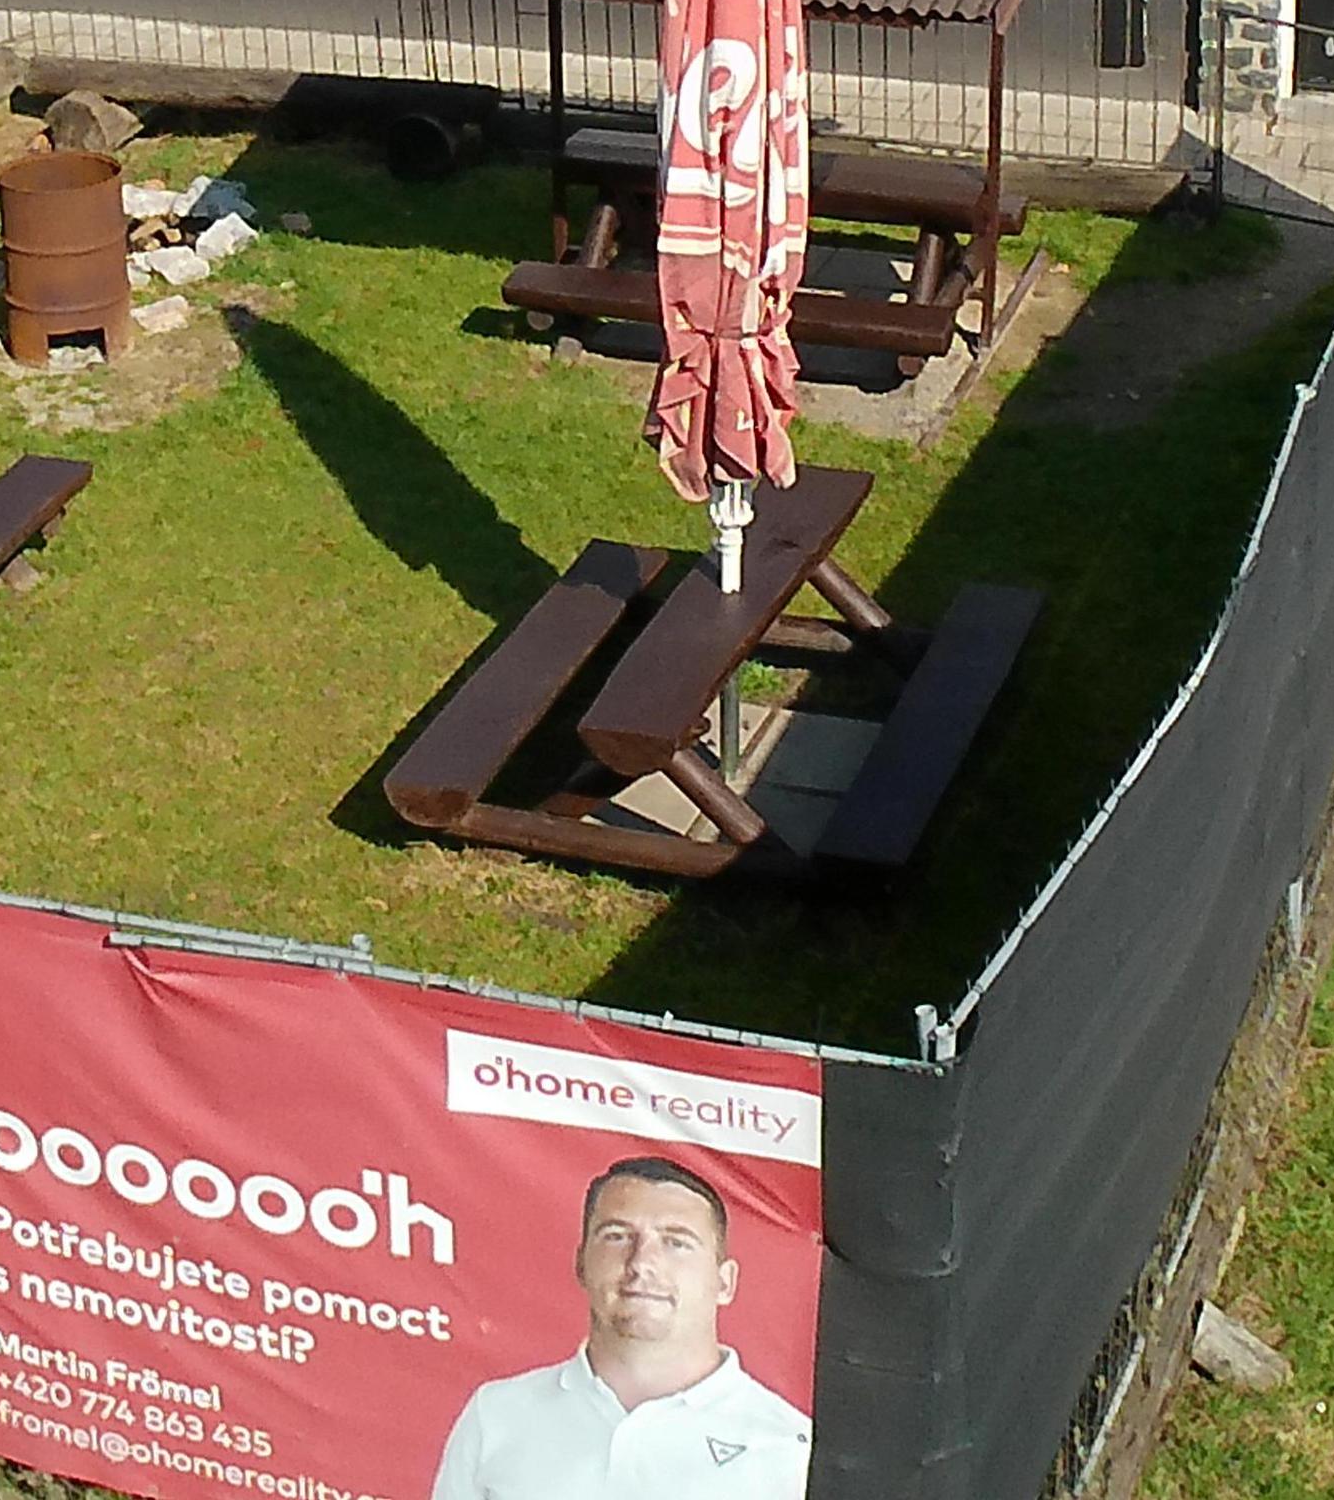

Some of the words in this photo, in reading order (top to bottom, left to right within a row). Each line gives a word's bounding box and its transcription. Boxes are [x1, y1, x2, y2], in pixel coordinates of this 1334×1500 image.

[649, 1096, 798, 1143] reality
[20, 1270, 316, 1365] nemovitostí?
[262, 1278, 453, 1341] pomoct
[105, 1360, 222, 1411] Frömel
[78, 1388, 136, 1428] 774
[144, 1408, 205, 1443] 863
[211, 1421, 274, 1459] 435
